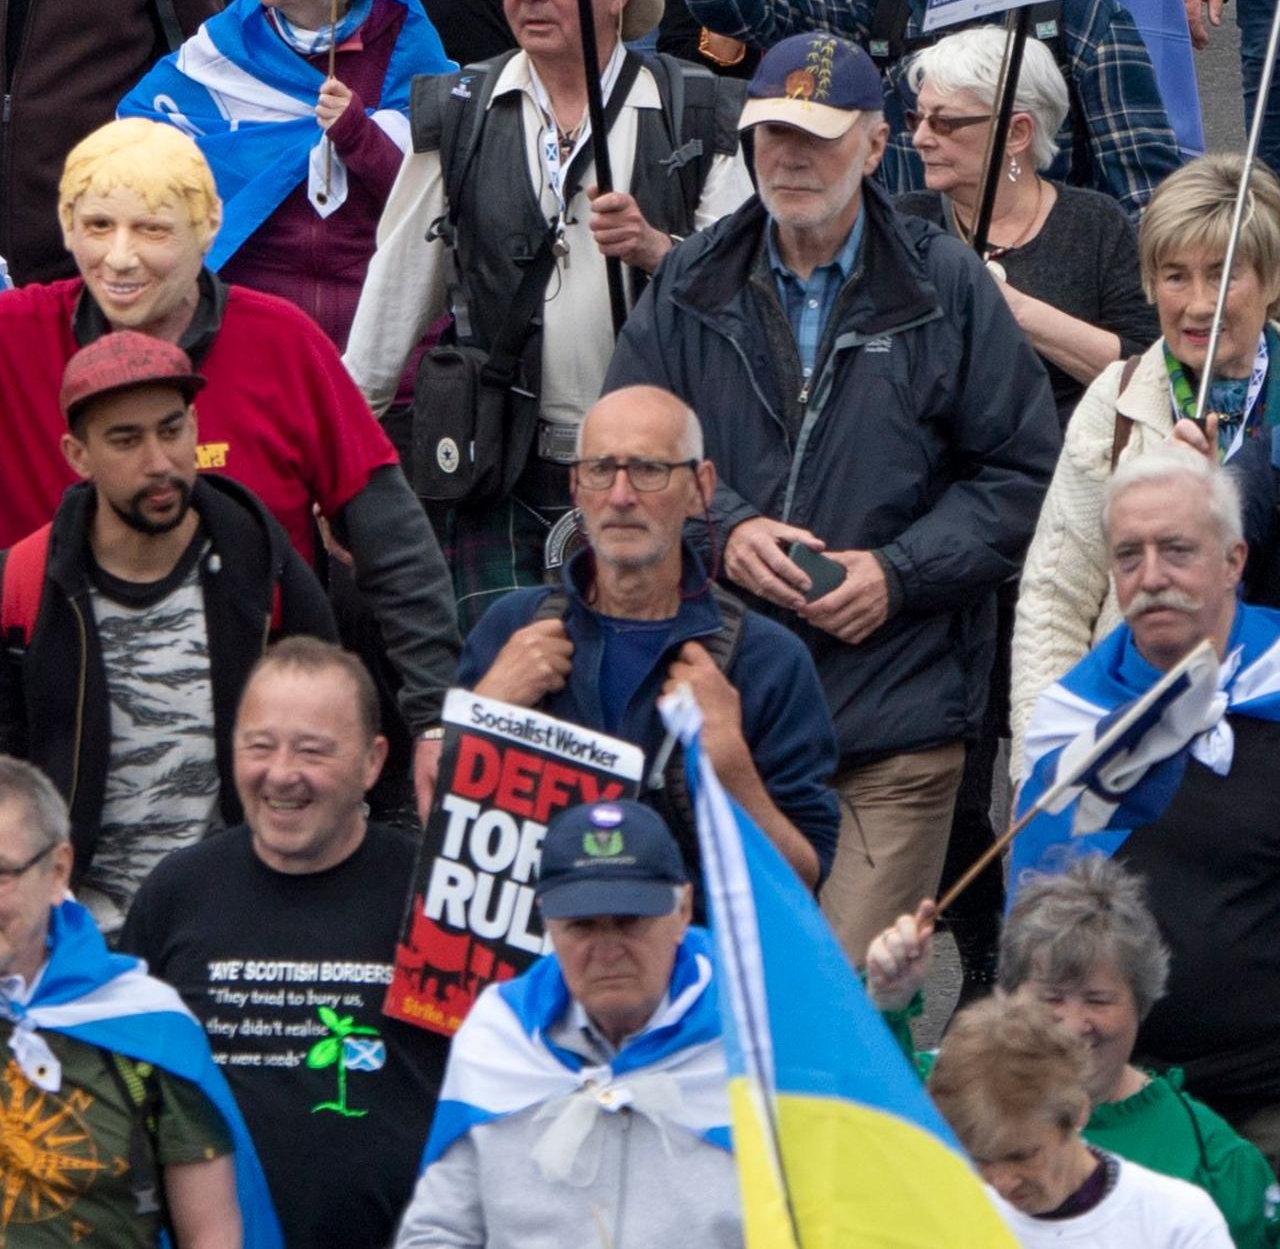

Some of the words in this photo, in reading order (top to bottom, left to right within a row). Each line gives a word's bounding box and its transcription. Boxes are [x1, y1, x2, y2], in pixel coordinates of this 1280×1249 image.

[470, 703, 555, 748] Socialist
[553, 726, 620, 769] Worker
[441, 793, 548, 885] TOR
[424, 856, 549, 956] RUL
[243, 961, 319, 982] SCOTTISH
[320, 961, 395, 985] BORDERS
[251, 988, 286, 1007] tried
[287, 991, 305, 1006] to
[306, 989, 341, 1009] bury
[342, 994, 365, 1008] us,
[206, 1016, 238, 1038] they
[239, 1018, 283, 1037] didn't
[229, 1052, 262, 1066] were
